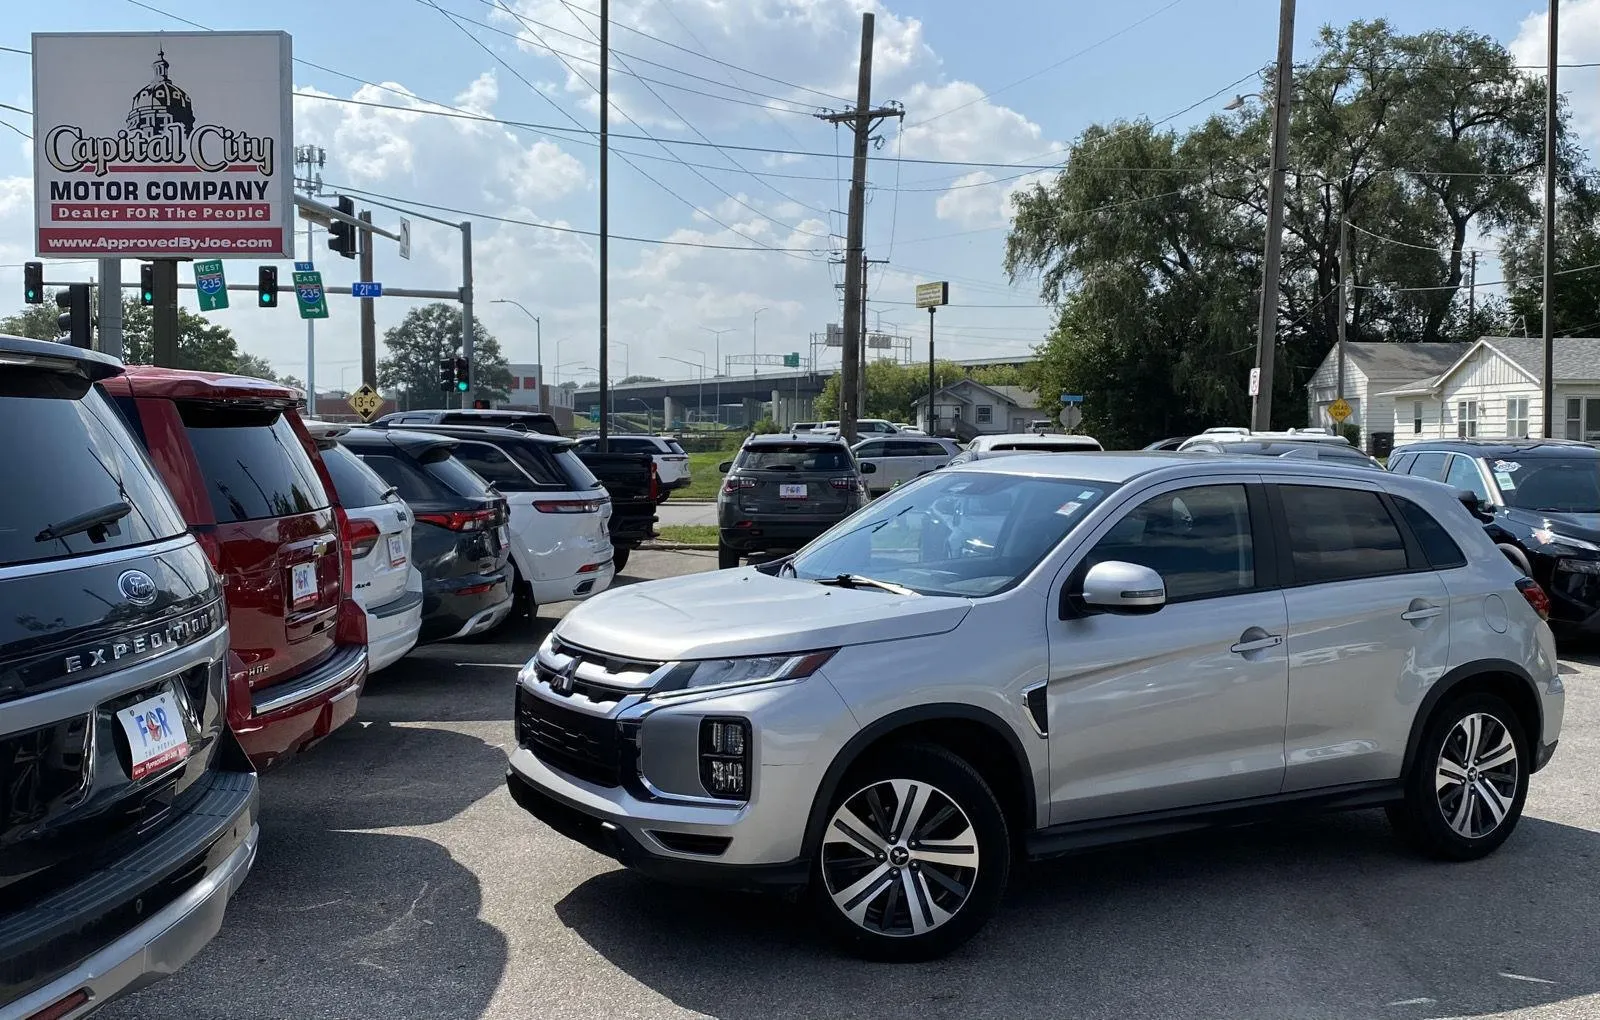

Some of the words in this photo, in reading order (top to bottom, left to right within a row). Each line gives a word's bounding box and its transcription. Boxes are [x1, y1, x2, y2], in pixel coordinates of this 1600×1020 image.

[44, 124, 186, 177] Capital
[190, 124, 274, 177] City
[50, 181, 138, 201] MOTOR
[146, 181, 269, 201] COMPANY
[58, 207, 119, 219] Dealer
[126, 207, 159, 219] FOR
[165, 207, 197, 219] The
[203, 207, 264, 221] People
[48, 237, 273, 251] www.ApprovedByJoe.com
[196, 263, 220, 273] WEST
[201, 277, 221, 290] 235
[295, 274, 318, 282] EAST
[301, 288, 321, 298] 235
[130, 576, 153, 596] Ford
[65, 613, 209, 673] EXPEDITION
